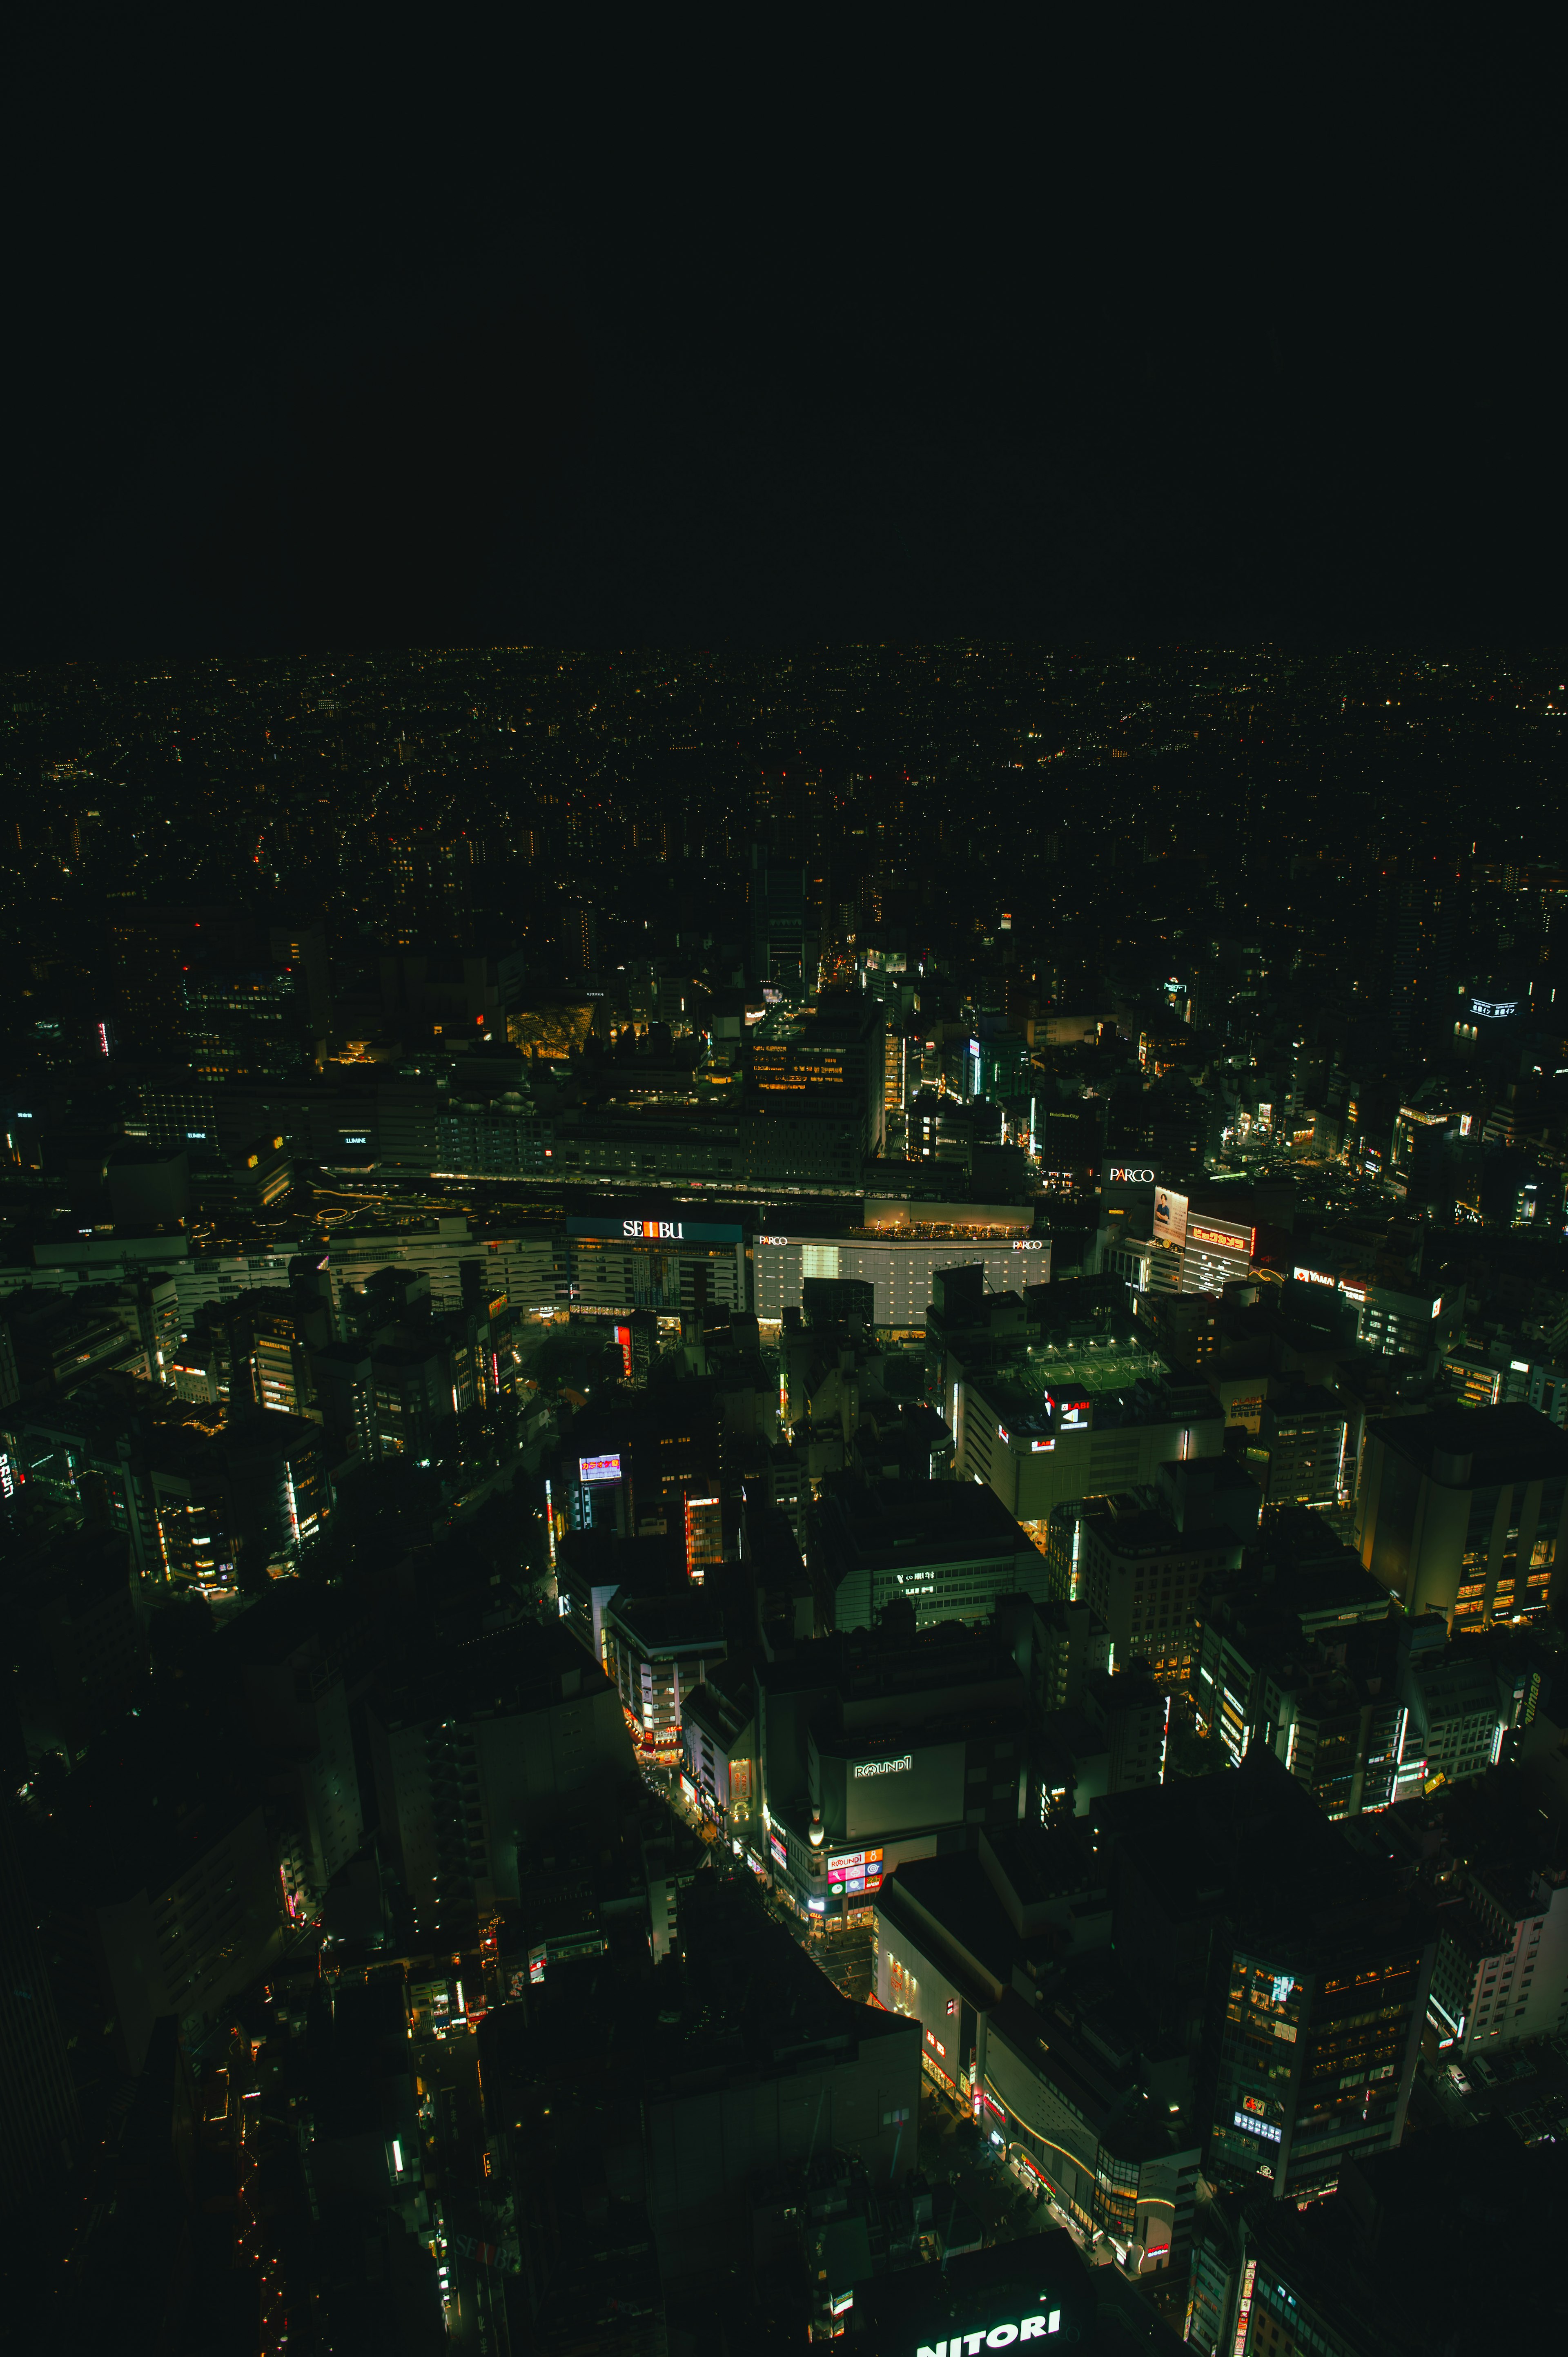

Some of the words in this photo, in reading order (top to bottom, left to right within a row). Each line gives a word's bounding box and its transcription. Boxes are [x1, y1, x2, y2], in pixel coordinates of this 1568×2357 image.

[1110, 1168, 1154, 1182] PARCO
[624, 1221, 684, 1239] SEIBU
[1193, 1228, 1244, 1249] ビックカメラ
[760, 1235, 788, 1245] PARCO
[1013, 1240, 1042, 1249] PARCO
[1068, 1402, 1090, 1410] LABI
[0, 1454, 14, 1498] サカゼン
[1525, 1672, 1541, 1725] animate
[855, 1755, 911, 1778] ROUND1
[831, 1854, 862, 1867] ROUND1
[917, 2309, 1060, 2357] NITORI
